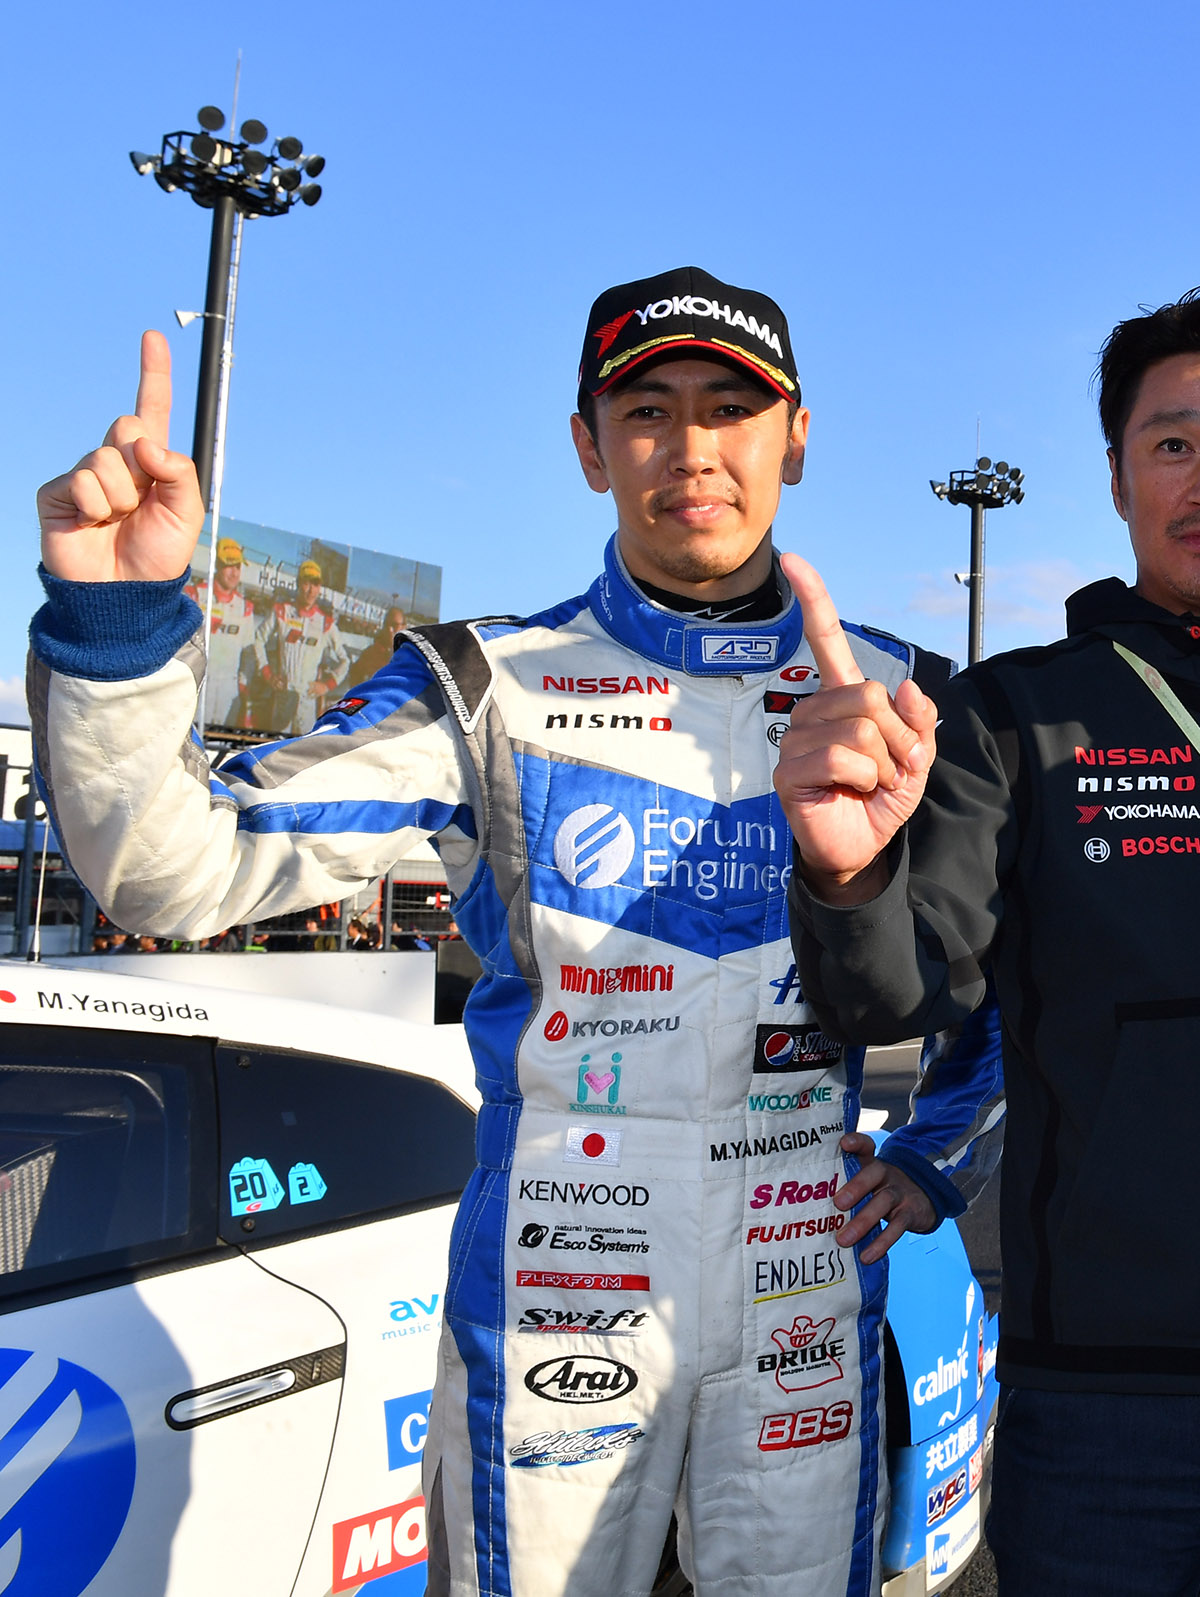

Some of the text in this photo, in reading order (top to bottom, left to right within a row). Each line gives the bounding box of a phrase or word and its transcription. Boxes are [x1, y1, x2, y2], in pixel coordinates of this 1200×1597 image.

[635, 295, 783, 359] YOKOHAMA
[713, 640, 772, 655] ARD
[543, 675, 669, 695] NISSAN
[546, 714, 672, 731] nismo
[1074, 745, 1193, 766] NISSAN
[1077, 775, 1196, 793] nismo
[643, 808, 776, 852] Forum
[37, 991, 209, 1022] M.Yanagida
[572, 1016, 680, 1038] KYORAKU
[568, 1103, 627, 1115] KINSHUKAI
[748, 1086, 832, 1112] WOODONE
[710, 1127, 822, 1162] M.YANAGIDA
[231, 1172, 267, 1203] 20
[296, 1176, 311, 1197] 2
[519, 1179, 650, 1207] KENWOOD
[750, 1173, 839, 1210] S Road
[746, 1213, 845, 1246] FUJITSUBO
[519, 1272, 622, 1289] FLEXFORM
[755, 1248, 846, 1294] ENDLESS
[389, 1293, 440, 1322] av
[381, 1323, 432, 1341] music
[757, 1338, 846, 1373] BRIDE
[532, 1360, 626, 1391] Arai
[913, 1347, 969, 1406] calmic
[759, 1401, 853, 1450] BBS
